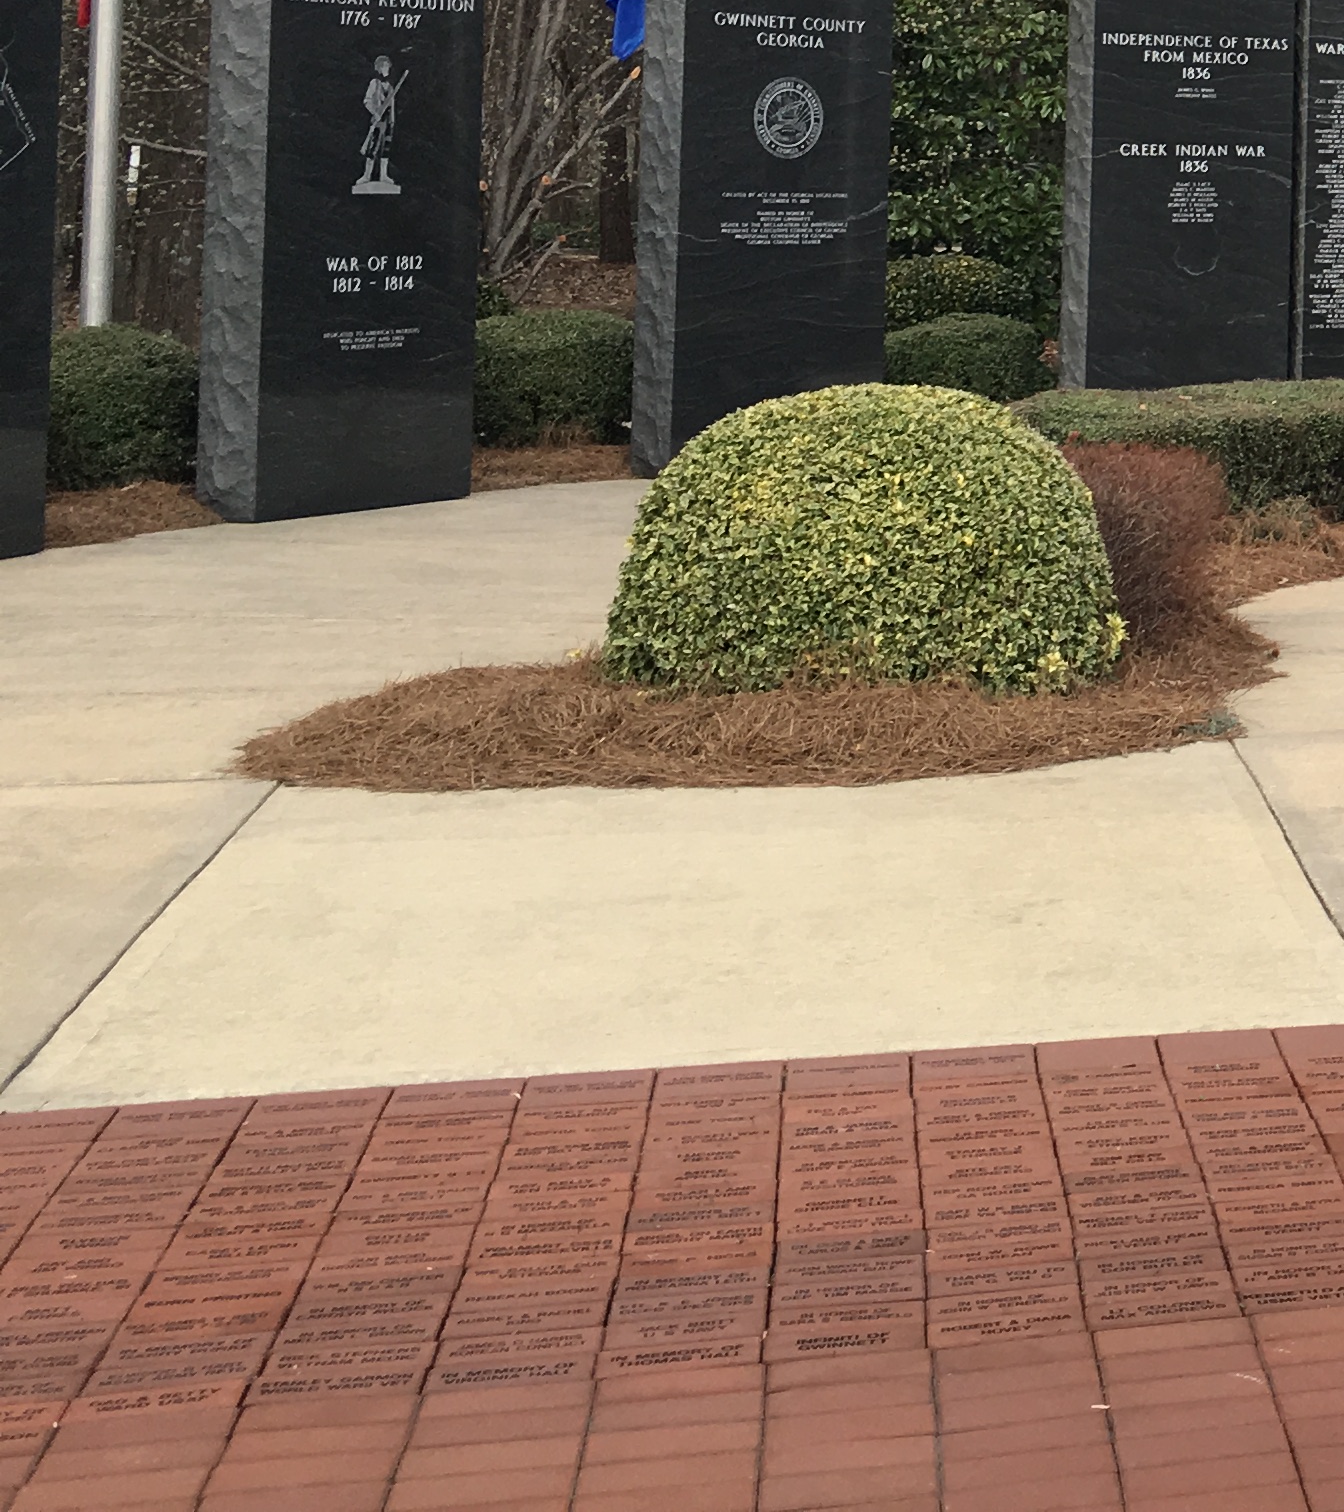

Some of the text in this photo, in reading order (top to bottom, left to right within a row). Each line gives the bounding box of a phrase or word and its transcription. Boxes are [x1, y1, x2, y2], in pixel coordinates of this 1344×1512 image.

[340, 10, 370, 27] 1776
[393, 13, 422, 29] 1787
[714, 11, 866, 33] GWINNETT COUNTY
[756, 32, 824, 49] GEORGIA
[1102, 33, 1289, 51] INDEPENDENCE OF TEXAS
[1143, 50, 1249, 65] FROM MEXICO
[1182, 67, 1211, 80] 1836
[1119, 143, 1266, 157] CREEK INDIAN WAR
[1179, 160, 1209, 173] 1836
[326, 255, 423, 272] WAR OF 1812
[332, 277, 361, 293] 1812
[385, 275, 414, 291] 1814
